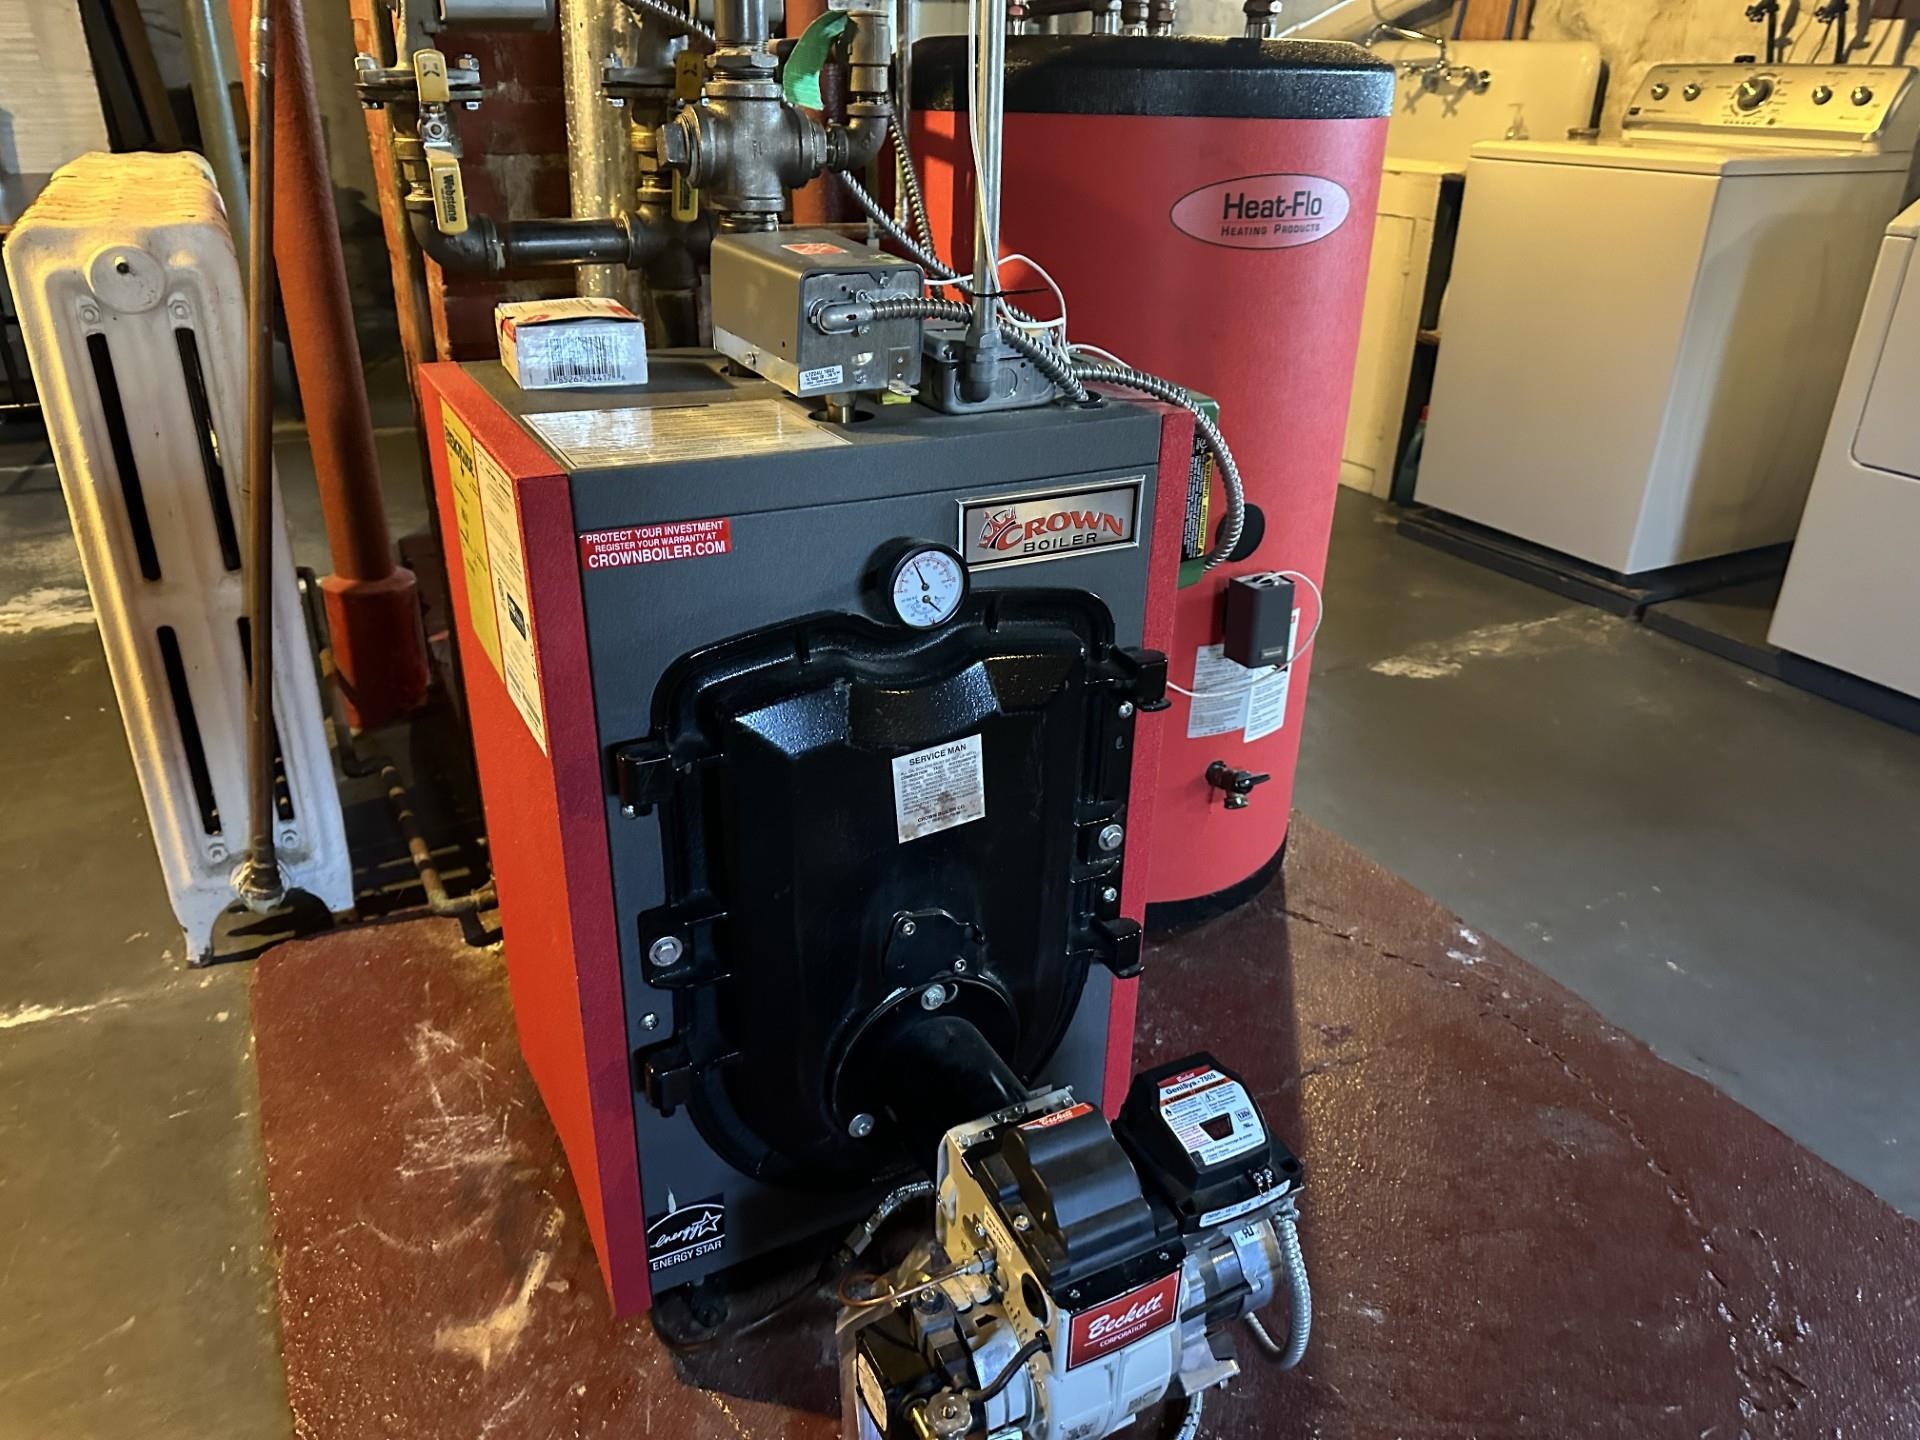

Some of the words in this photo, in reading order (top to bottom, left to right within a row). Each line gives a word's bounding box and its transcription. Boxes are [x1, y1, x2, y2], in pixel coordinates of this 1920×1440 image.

[443, 174, 458, 223] Webstone
[1222, 190, 1323, 220] Heat-Flo
[586, 530, 633, 544] PROTECT
[635, 527, 663, 539] YOUR
[664, 520, 724, 536] INVESTMENT
[594, 541, 636, 553] REGISTER
[637, 538, 660, 548] YOUR
[661, 533, 705, 546] WARRANTY
[706, 531, 717, 541] AT
[995, 511, 1124, 551] CROWN
[1023, 532, 1098, 553] BOILER
[588, 540, 726, 569] CROWNBOILER.COM
[909, 749, 946, 766] SERVICE
[947, 743, 967, 755] MAN
[652, 1249, 694, 1271] ENERGY
[695, 1240, 722, 1256] STAR
[1088, 1292, 1163, 1339] Beckett
[1100, 1322, 1147, 1347] CORPORATION
